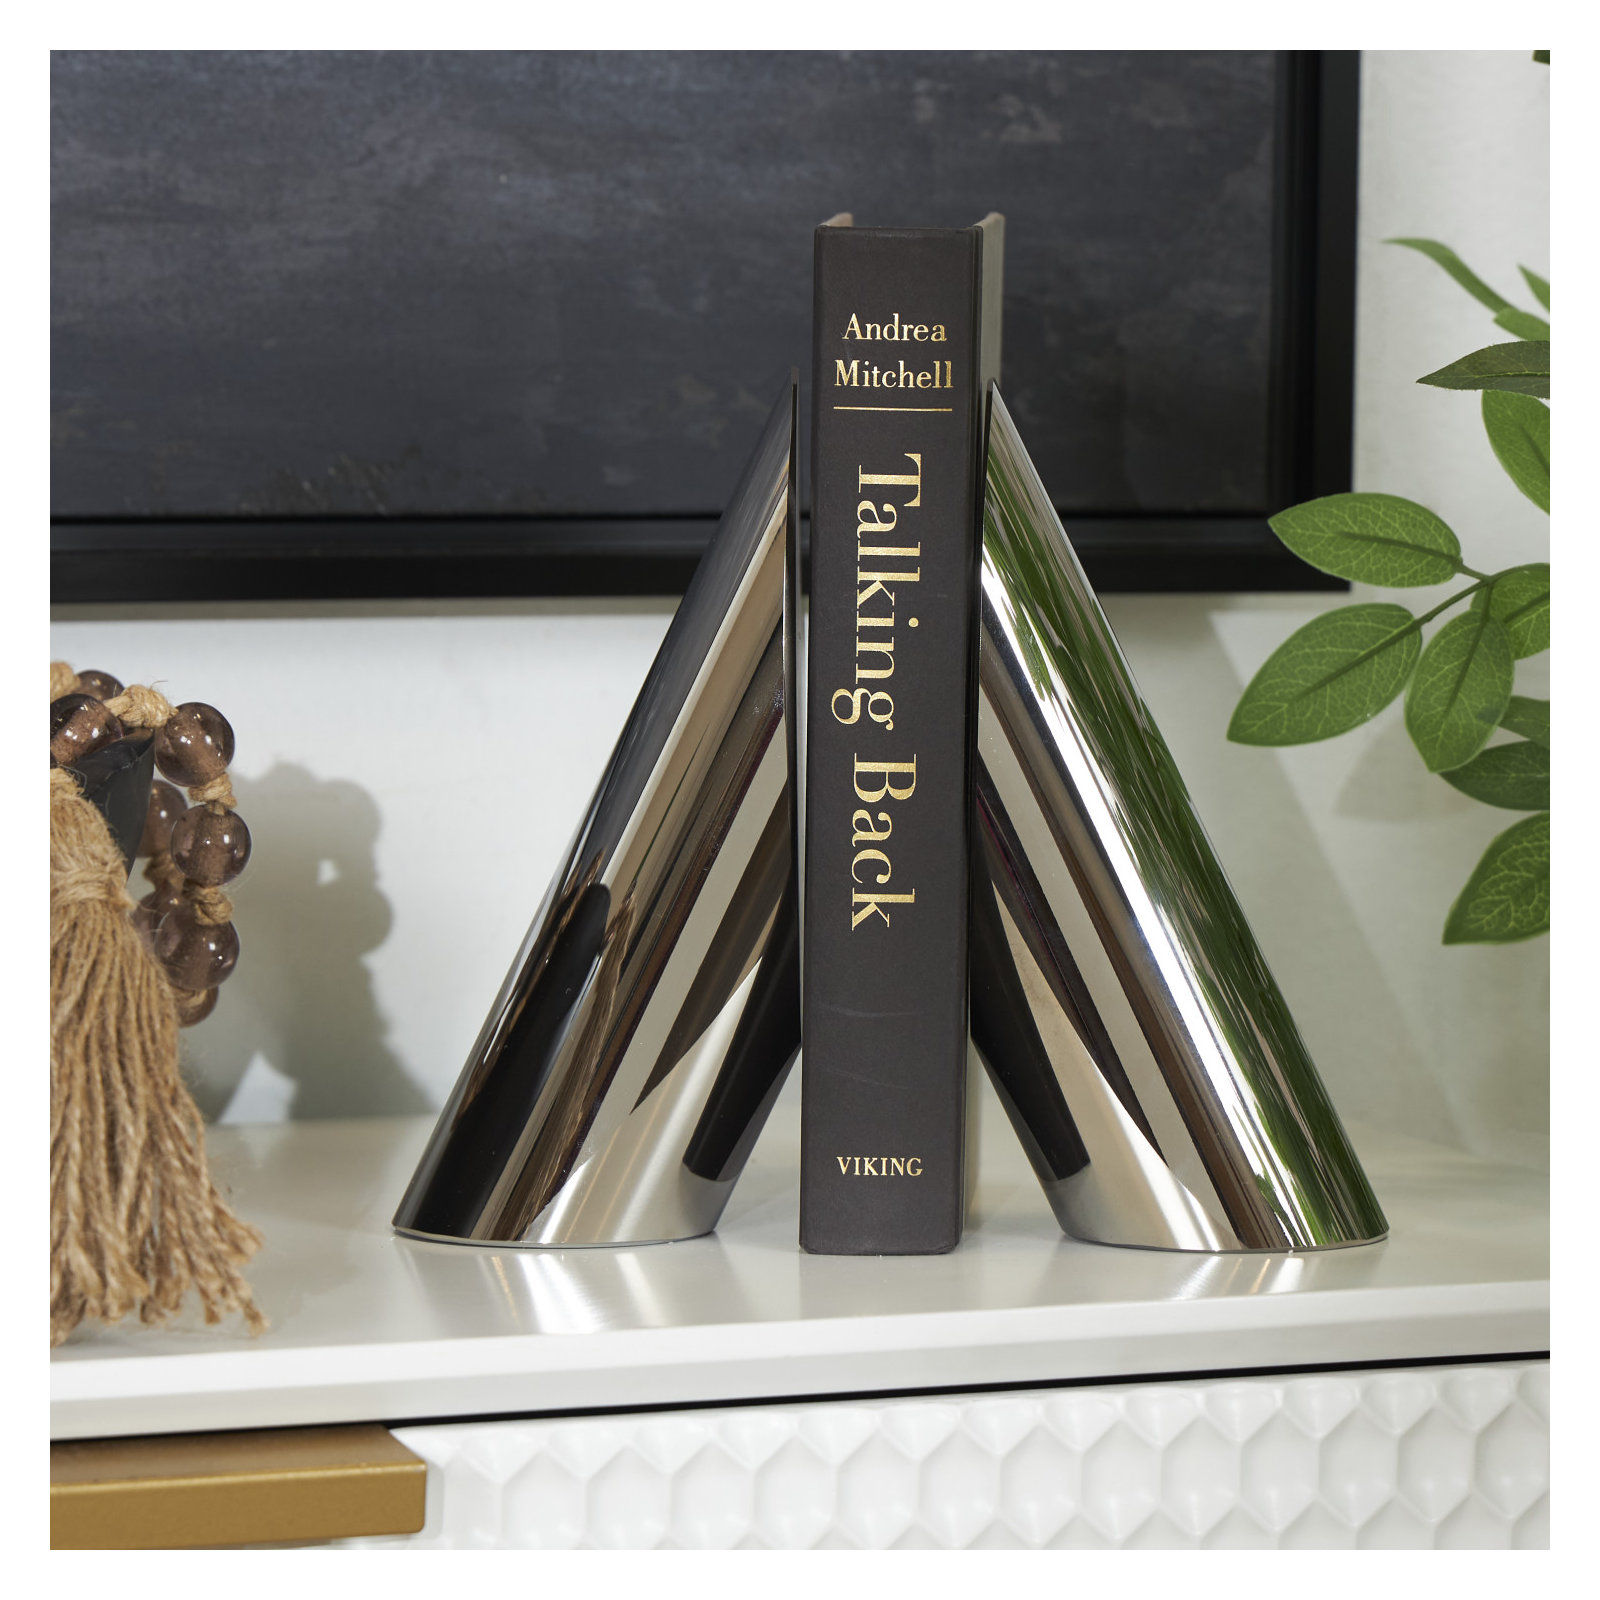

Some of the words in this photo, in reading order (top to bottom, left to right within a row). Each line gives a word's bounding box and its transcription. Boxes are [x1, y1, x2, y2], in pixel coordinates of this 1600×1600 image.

[842, 312, 948, 342] Andrea
[834, 359, 953, 390] Mitchell
[831, 452, 922, 731] Talking
[850, 753, 918, 931] Back
[836, 1156, 924, 1177] VIKING
